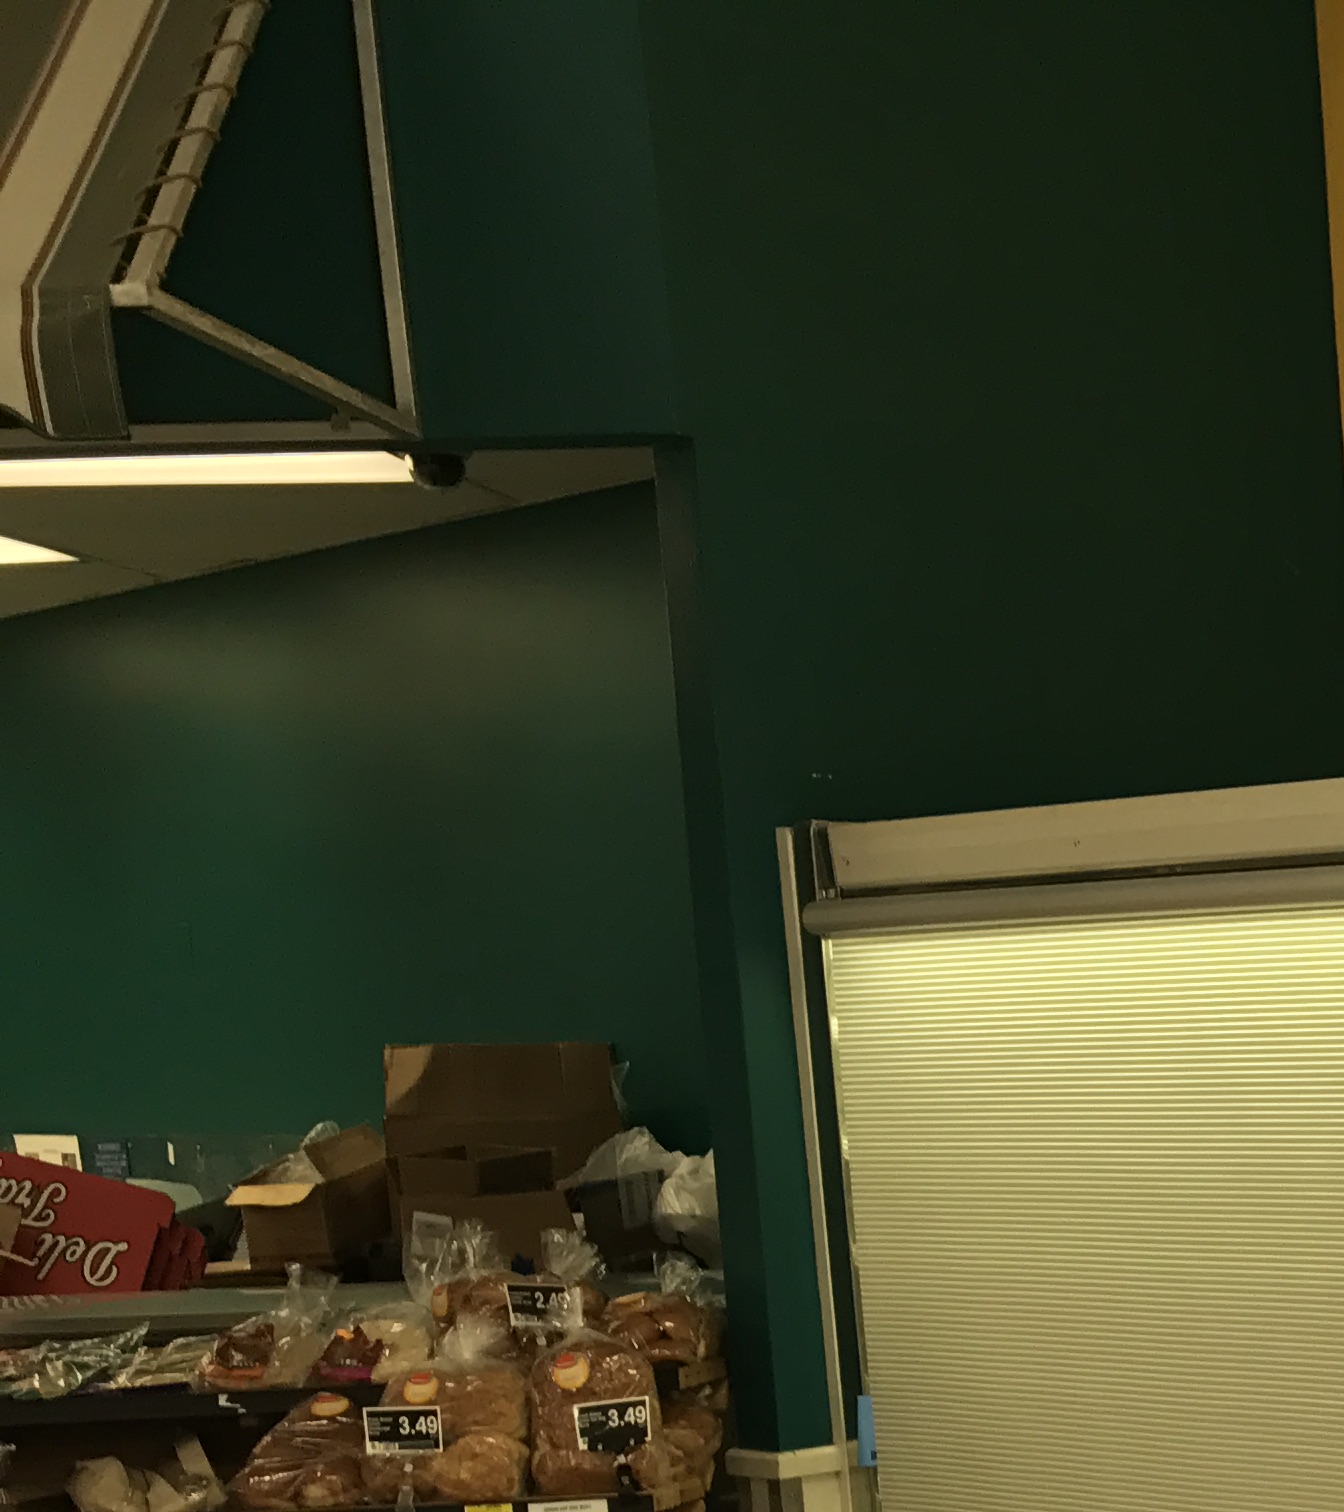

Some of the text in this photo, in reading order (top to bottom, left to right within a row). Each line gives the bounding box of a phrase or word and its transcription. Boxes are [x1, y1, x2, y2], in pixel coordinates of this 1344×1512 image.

[35, 1232, 130, 1288] Deli
[398, 1416, 439, 1436] 3.49
[607, 1405, 647, 1428] 3.49
